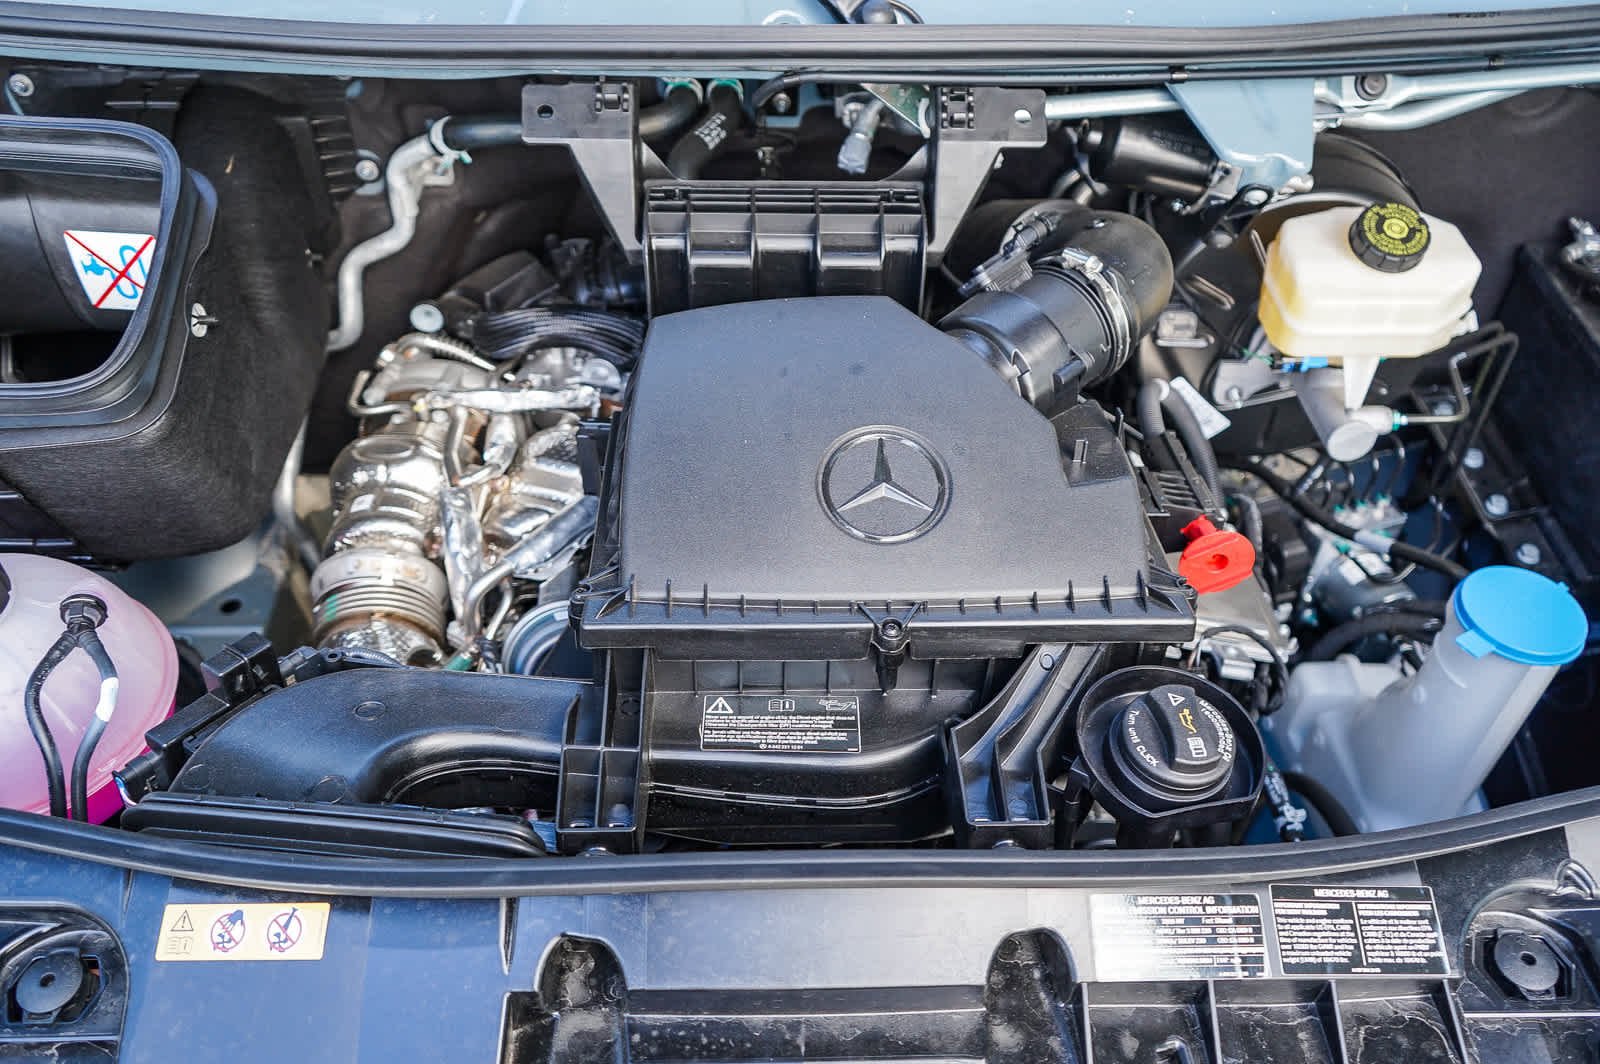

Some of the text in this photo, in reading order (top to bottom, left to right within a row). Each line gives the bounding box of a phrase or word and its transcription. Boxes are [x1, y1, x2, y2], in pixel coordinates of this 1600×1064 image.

[1127, 710, 1160, 767] Turn until CLICK
[1168, 906, 1205, 915] CONTROL
[1206, 906, 1260, 914] INFORMATION
